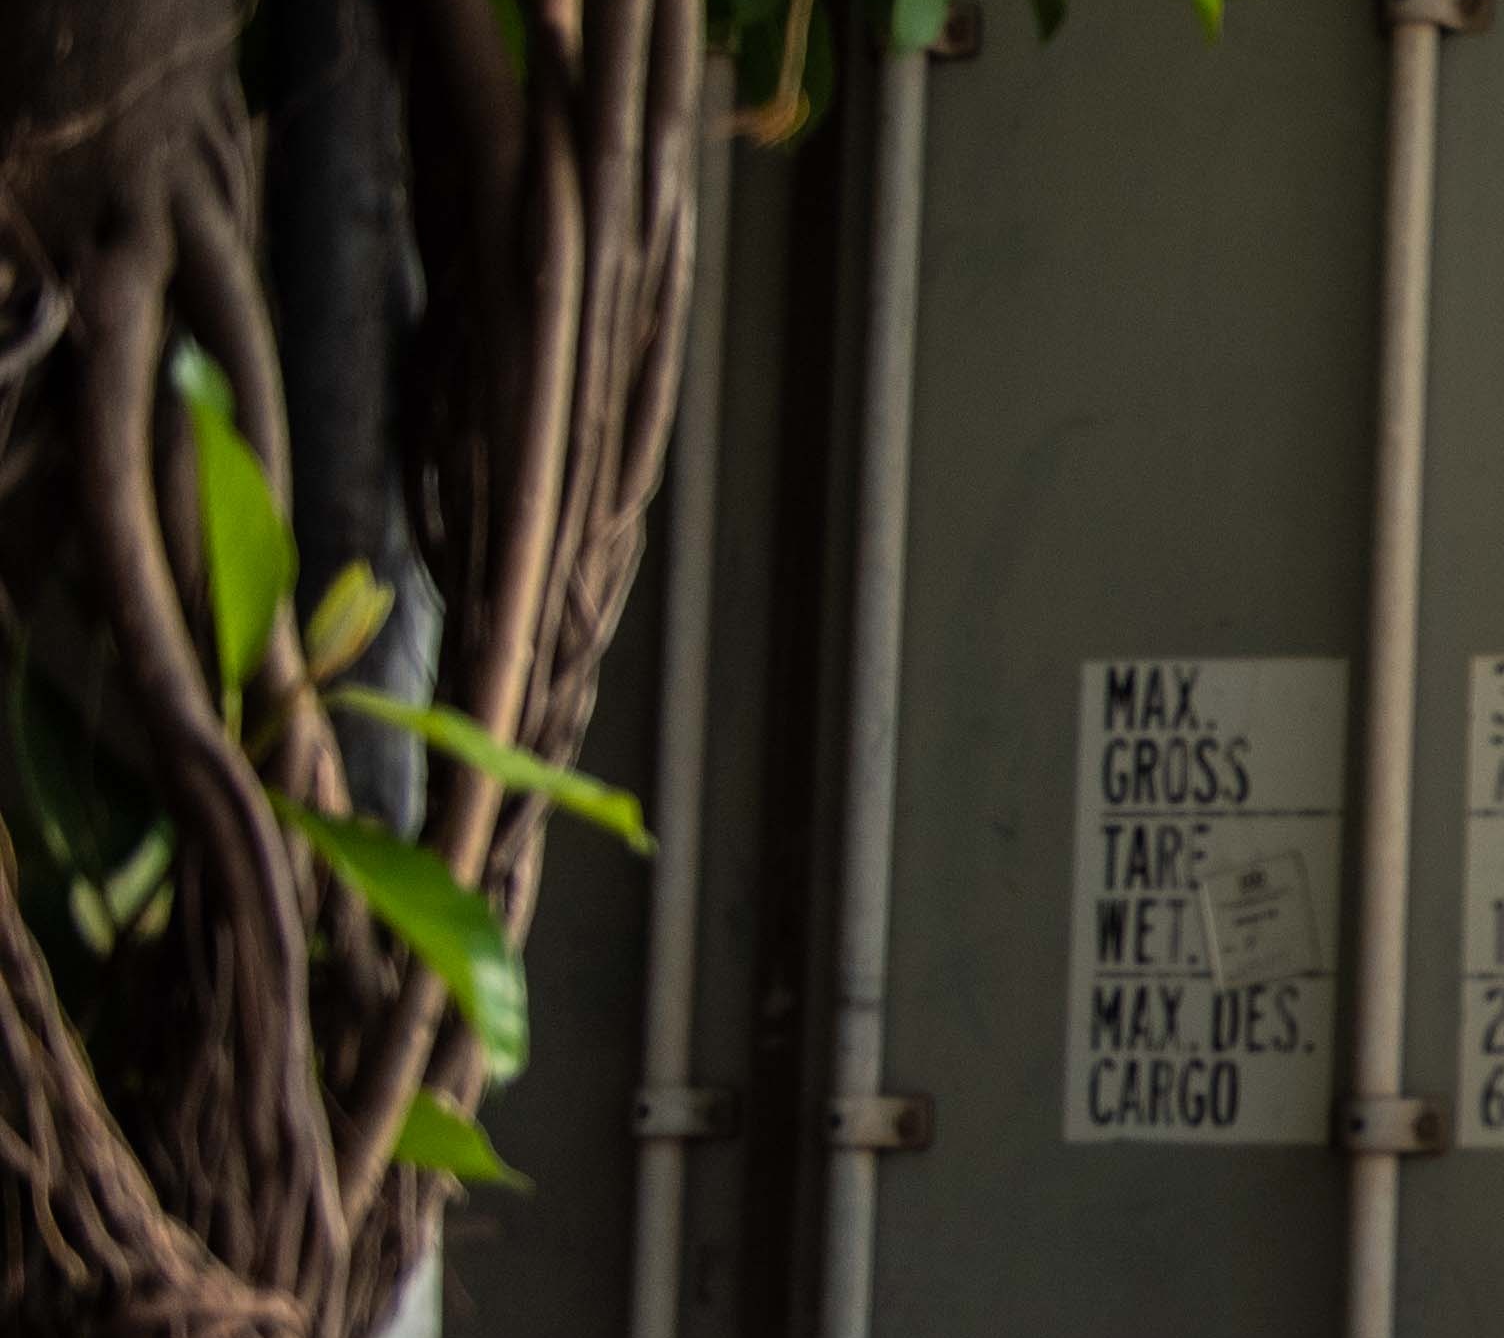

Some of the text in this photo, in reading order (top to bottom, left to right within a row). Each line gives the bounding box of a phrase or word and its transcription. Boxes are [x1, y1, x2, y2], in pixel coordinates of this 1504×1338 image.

[1104, 665, 1217, 731] MAX.
[1103, 737, 1249, 805] GROSS
[1103, 824, 1211, 890] TARE
[1211, 983, 1316, 1053] DES.
[1088, 1058, 1240, 1127] CARGO
